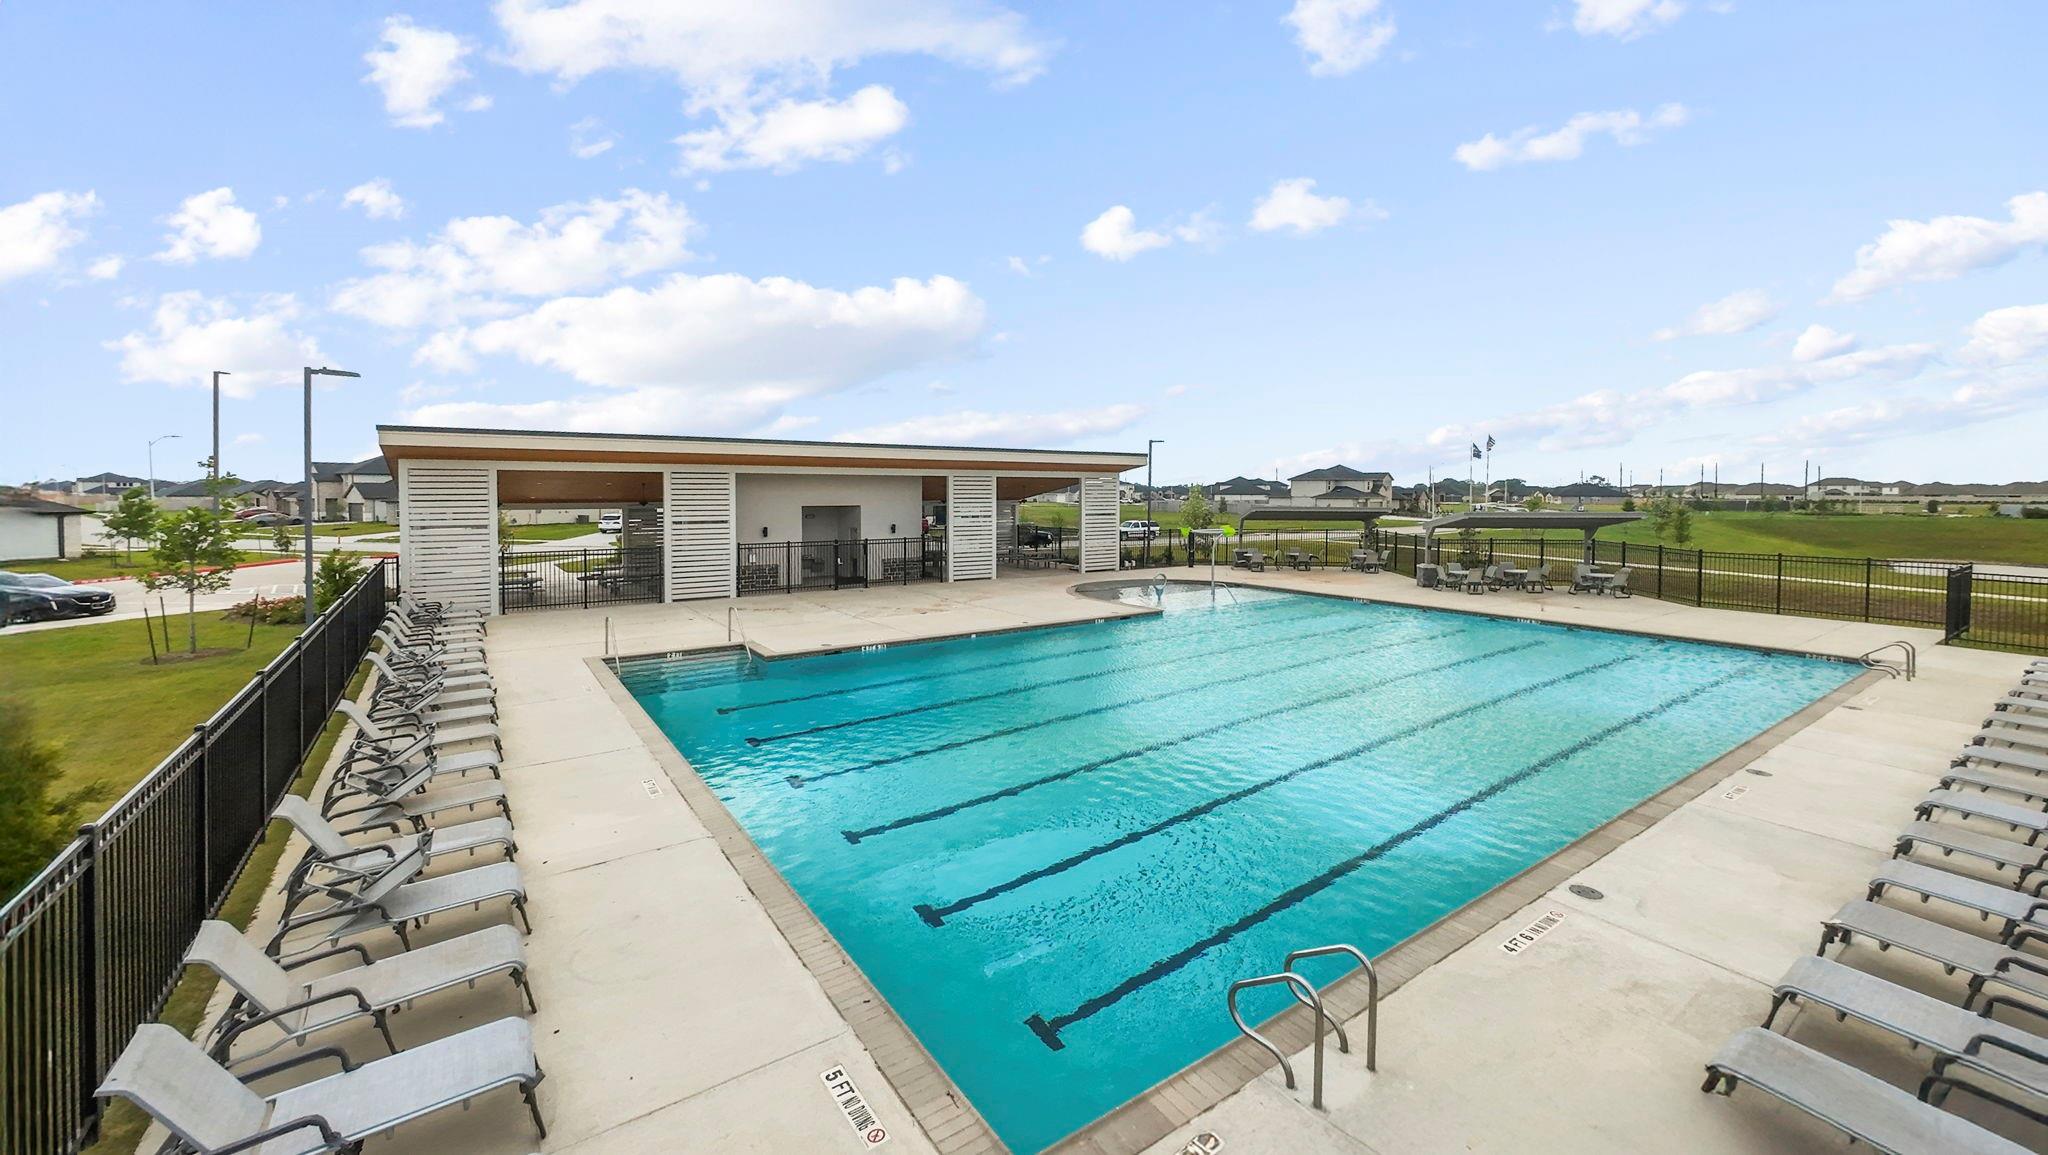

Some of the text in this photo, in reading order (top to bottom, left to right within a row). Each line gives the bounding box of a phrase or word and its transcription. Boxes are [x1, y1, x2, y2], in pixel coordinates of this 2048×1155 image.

[1519, 933, 1534, 941] 6
[1508, 937, 1527, 949] FT
[1503, 944, 1518, 953] 4
[825, 1069, 876, 1132] 5 FT NO DIVING
